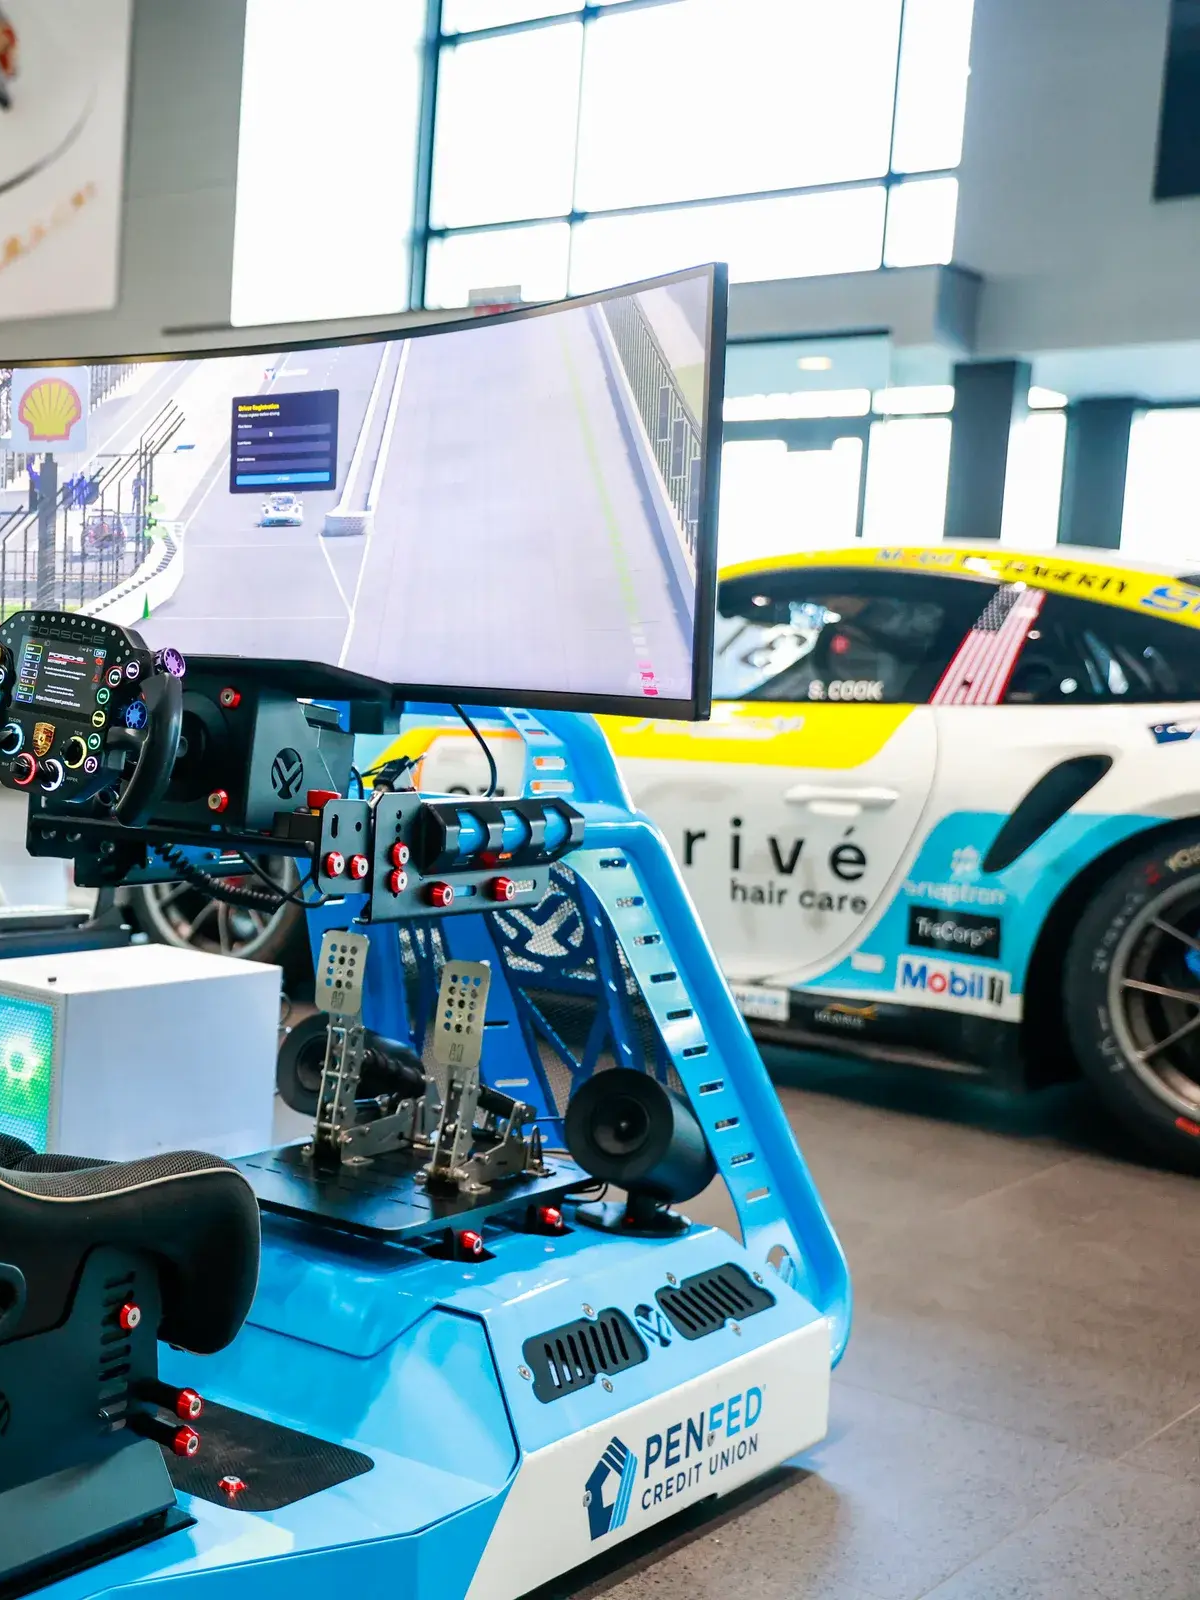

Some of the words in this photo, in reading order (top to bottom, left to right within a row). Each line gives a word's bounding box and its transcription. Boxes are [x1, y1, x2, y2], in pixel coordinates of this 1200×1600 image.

[27, 625, 106, 645] PORSCHE
[48, 652, 84, 662] PORSCHE
[828, 680, 884, 701] COOK
[86, 760, 95, 769] F+
[731, 878, 789, 907] hair
[798, 888, 868, 914] care
[901, 962, 984, 999] Mobil
[644, 1386, 764, 1479] PENFED
[641, 1462, 703, 1510] CREDIT
[709, 1433, 759, 1475] UNION
